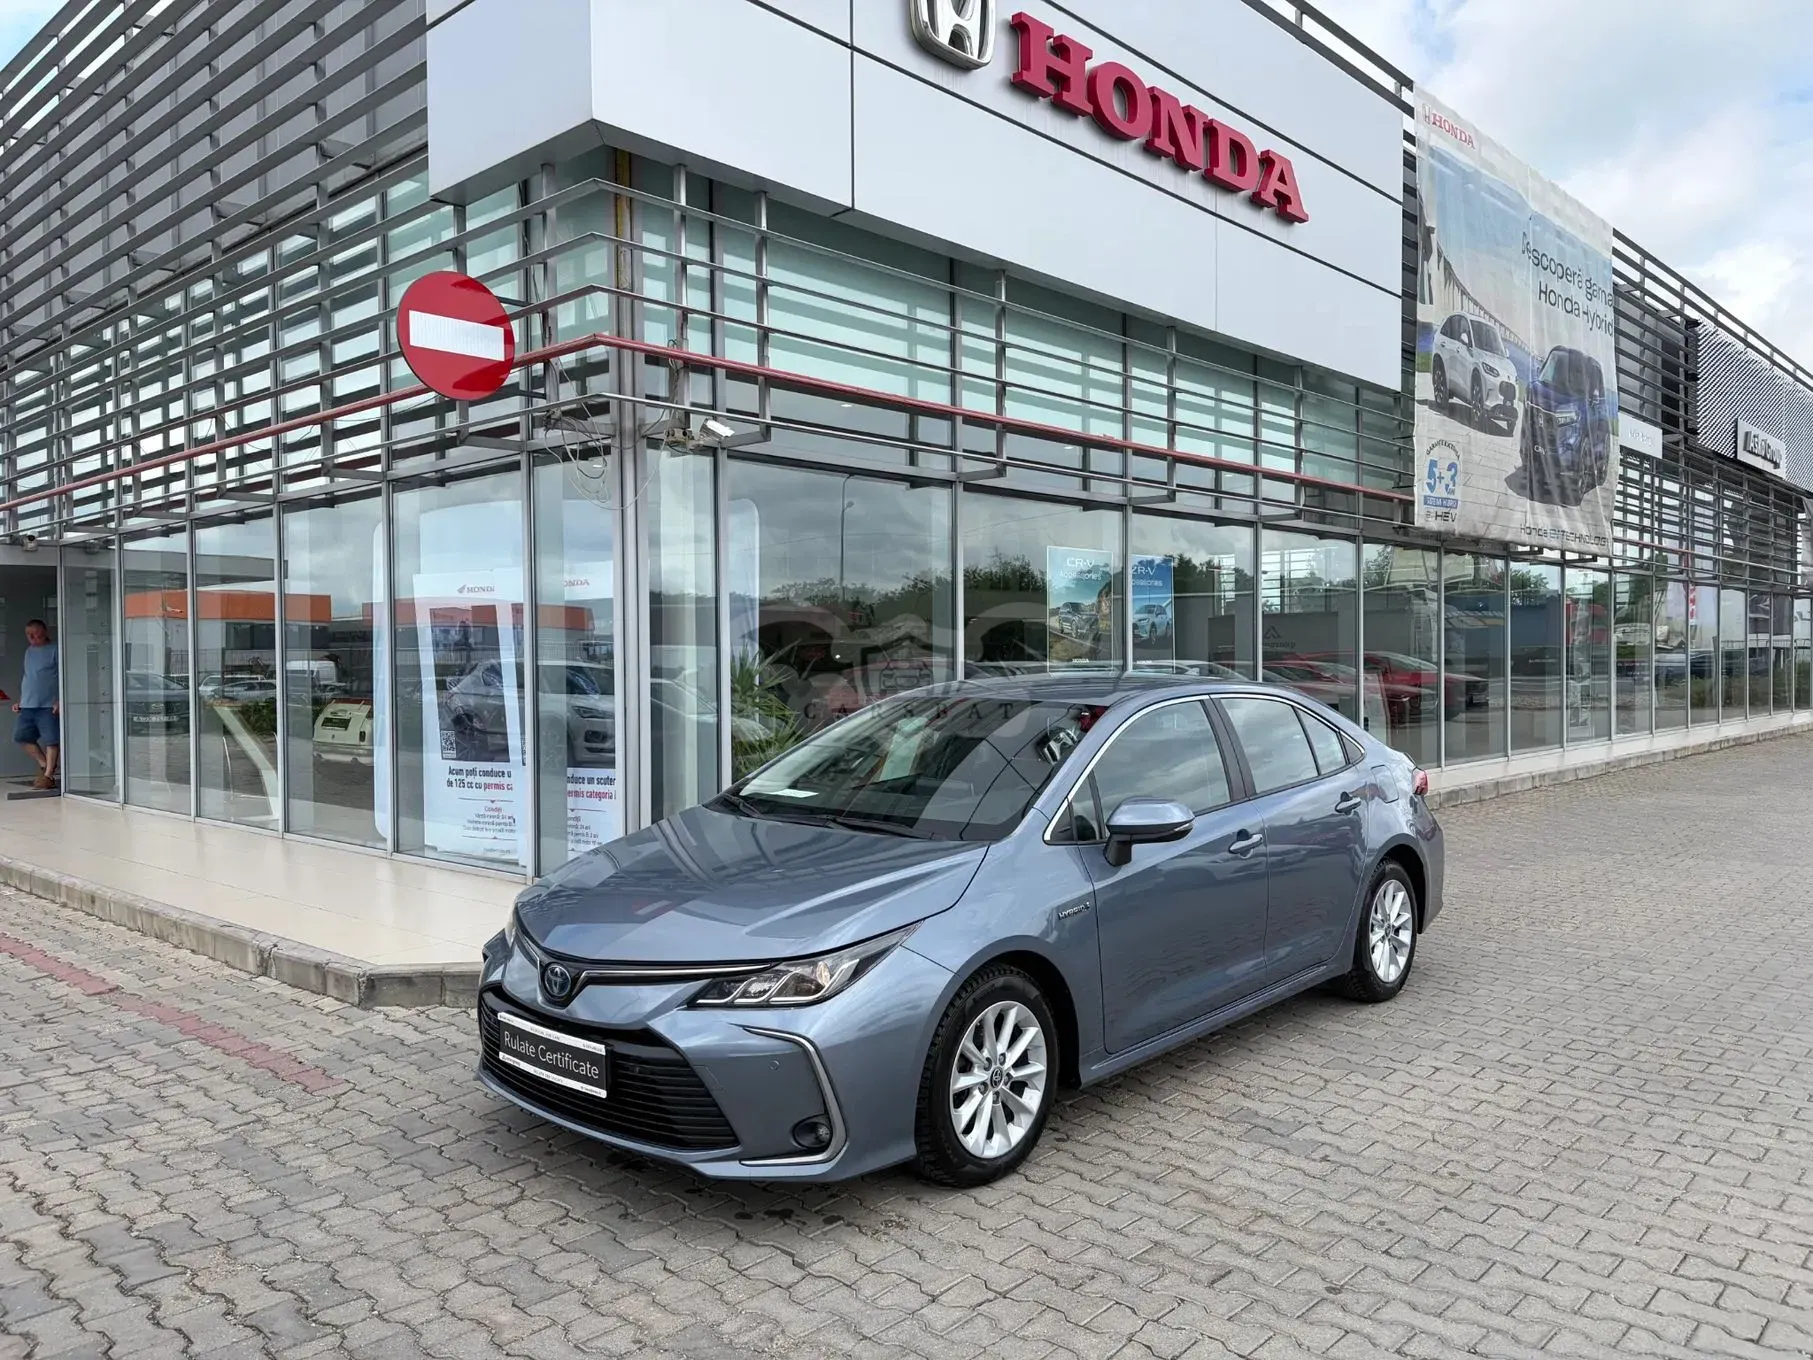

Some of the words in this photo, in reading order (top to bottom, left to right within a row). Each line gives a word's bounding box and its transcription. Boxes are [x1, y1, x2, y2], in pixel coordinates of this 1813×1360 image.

[1010, 11, 1309, 224] HONDA
[1432, 112, 1475, 150] HONDA
[1538, 281, 1581, 319] Honda
[446, 778, 454, 787] de
[454, 778, 466, 789] 125
[466, 781, 474, 789] cc
[474, 782, 483, 790] cu
[483, 781, 506, 791] permis
[448, 765, 465, 776] Acum
[478, 767, 506, 778] conduce
[587, 776, 595, 785] un
[504, 1031, 536, 1058] Rulate
[537, 1045, 599, 1079] Certificate
